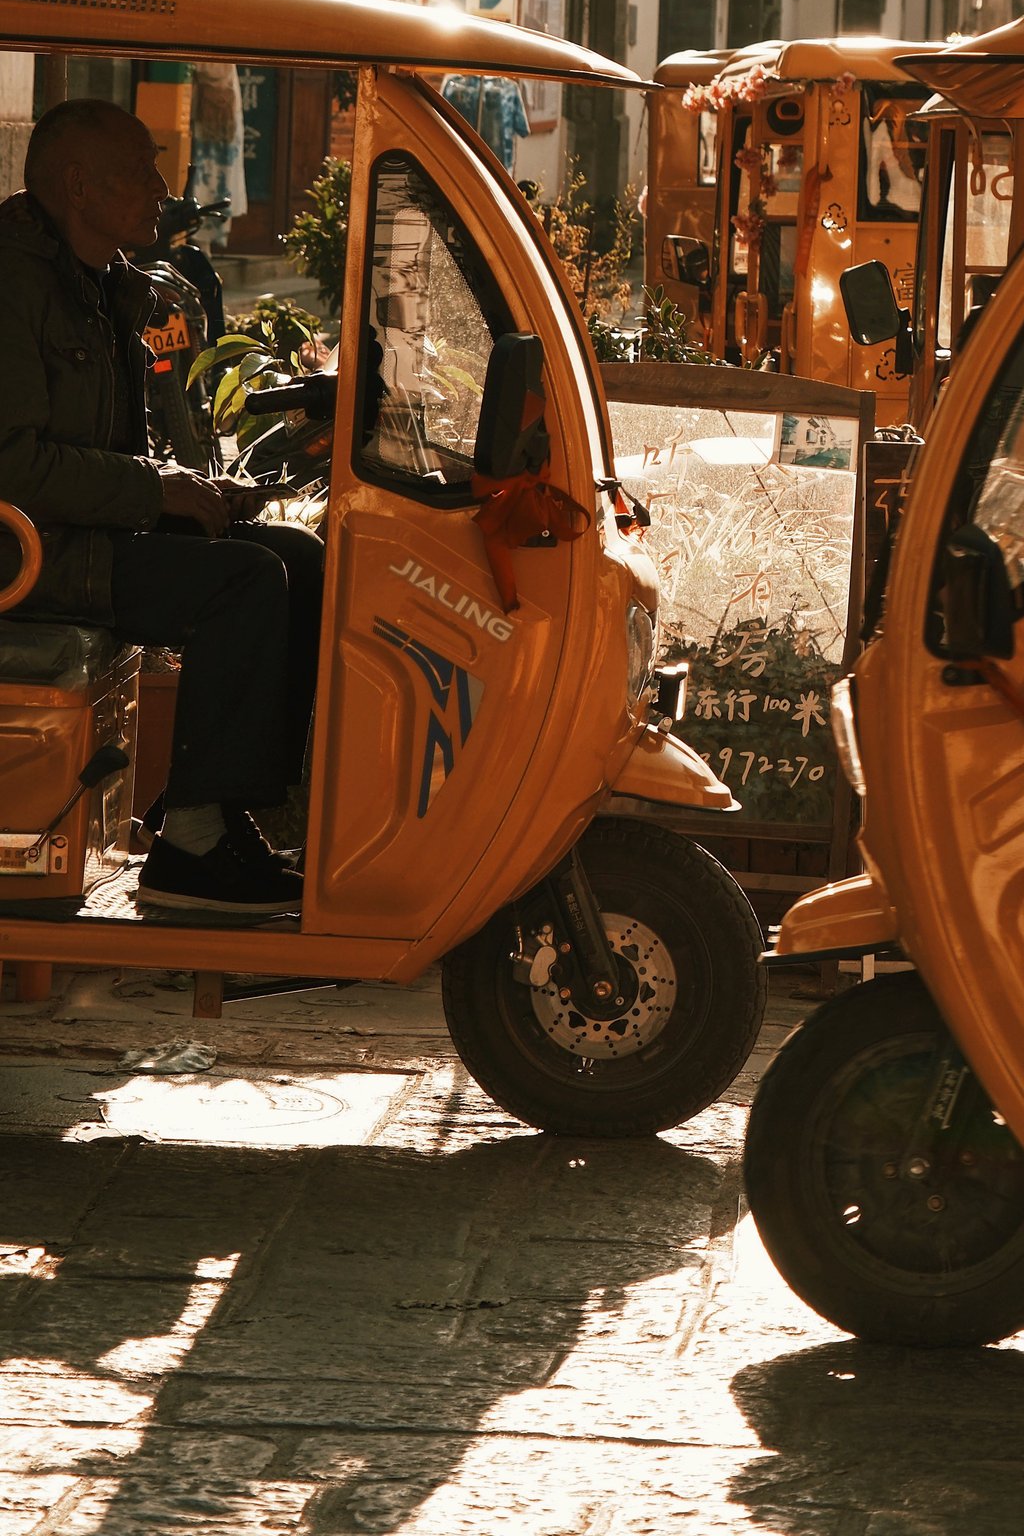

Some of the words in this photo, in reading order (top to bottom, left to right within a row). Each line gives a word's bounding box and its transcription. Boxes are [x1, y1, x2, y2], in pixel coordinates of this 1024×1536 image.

[389, 559, 514, 642] JIALING
[690, 688, 827, 737] 东行100米
